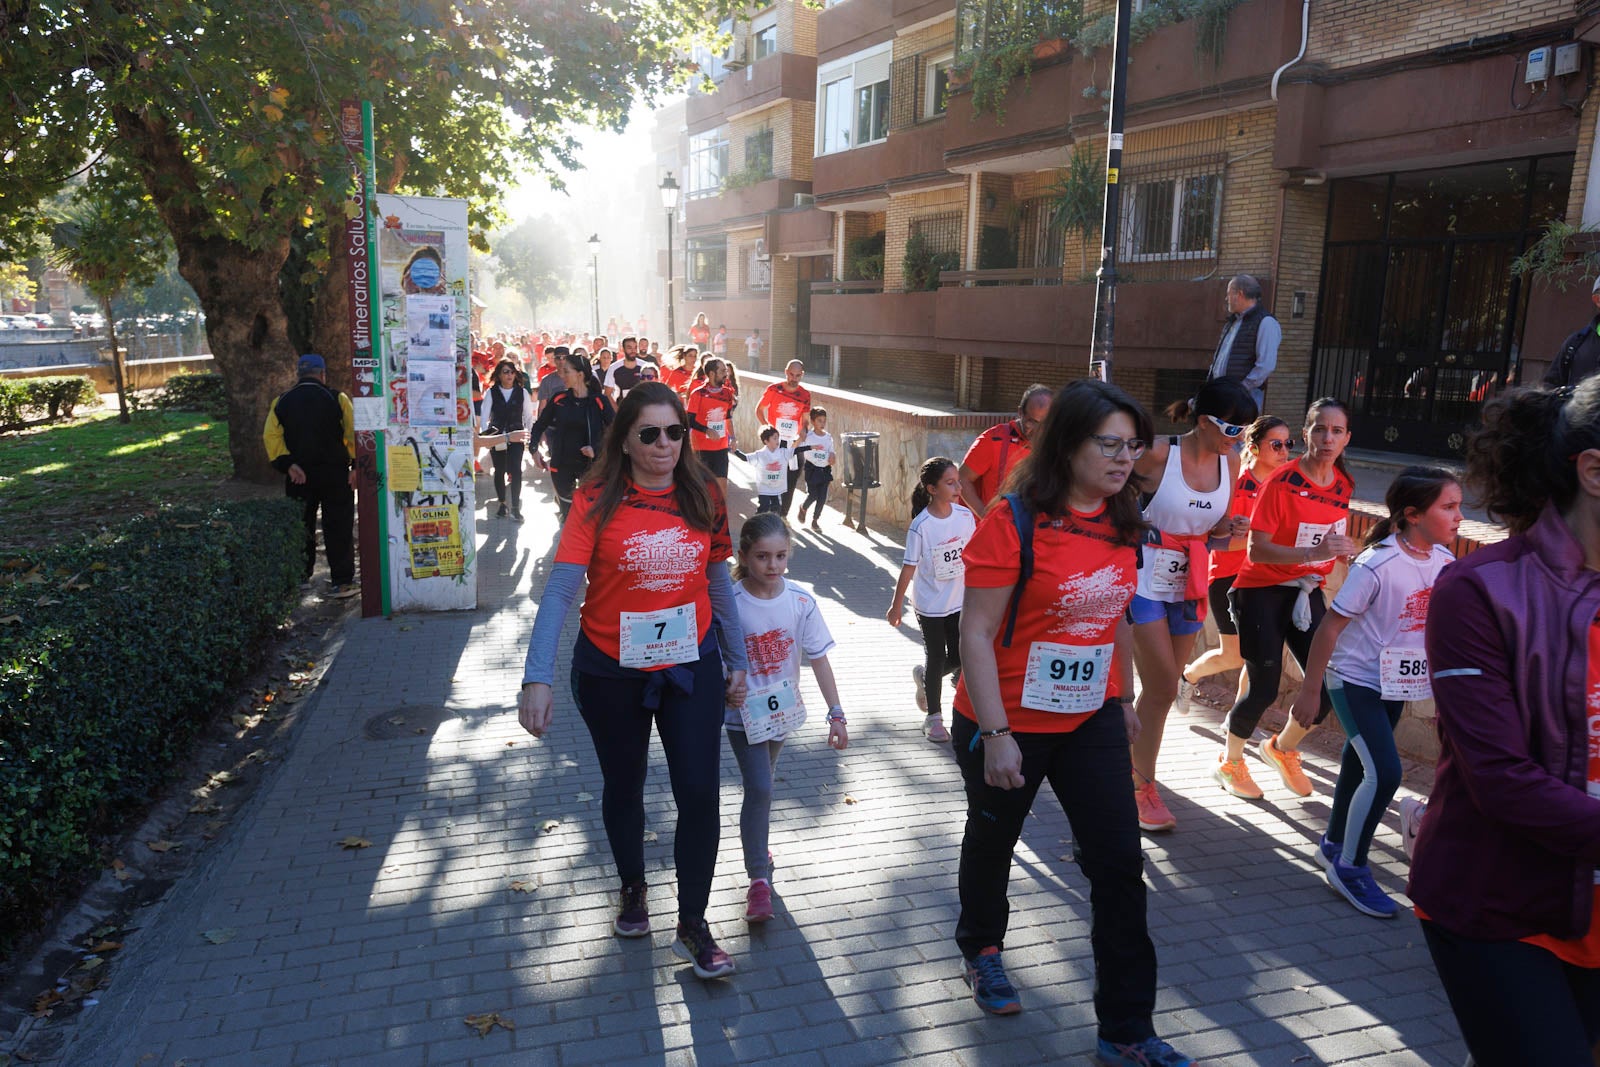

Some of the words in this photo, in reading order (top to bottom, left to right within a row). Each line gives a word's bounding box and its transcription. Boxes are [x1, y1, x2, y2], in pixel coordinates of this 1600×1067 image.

[350, 261, 368, 343] tinerarios
[1188, 499, 1212, 510] FILA
[626, 545, 697, 560] carrera
[626, 558, 696, 572] cruzroja.es
[1060, 588, 1130, 607] carrera
[654, 621, 667, 640] 7
[645, 642, 664, 650] MARIA
[1049, 658, 1094, 681] 919
[1398, 659, 1428, 676] 589
[1053, 683, 1091, 692] INMACULADA
[767, 695, 779, 711] 6
